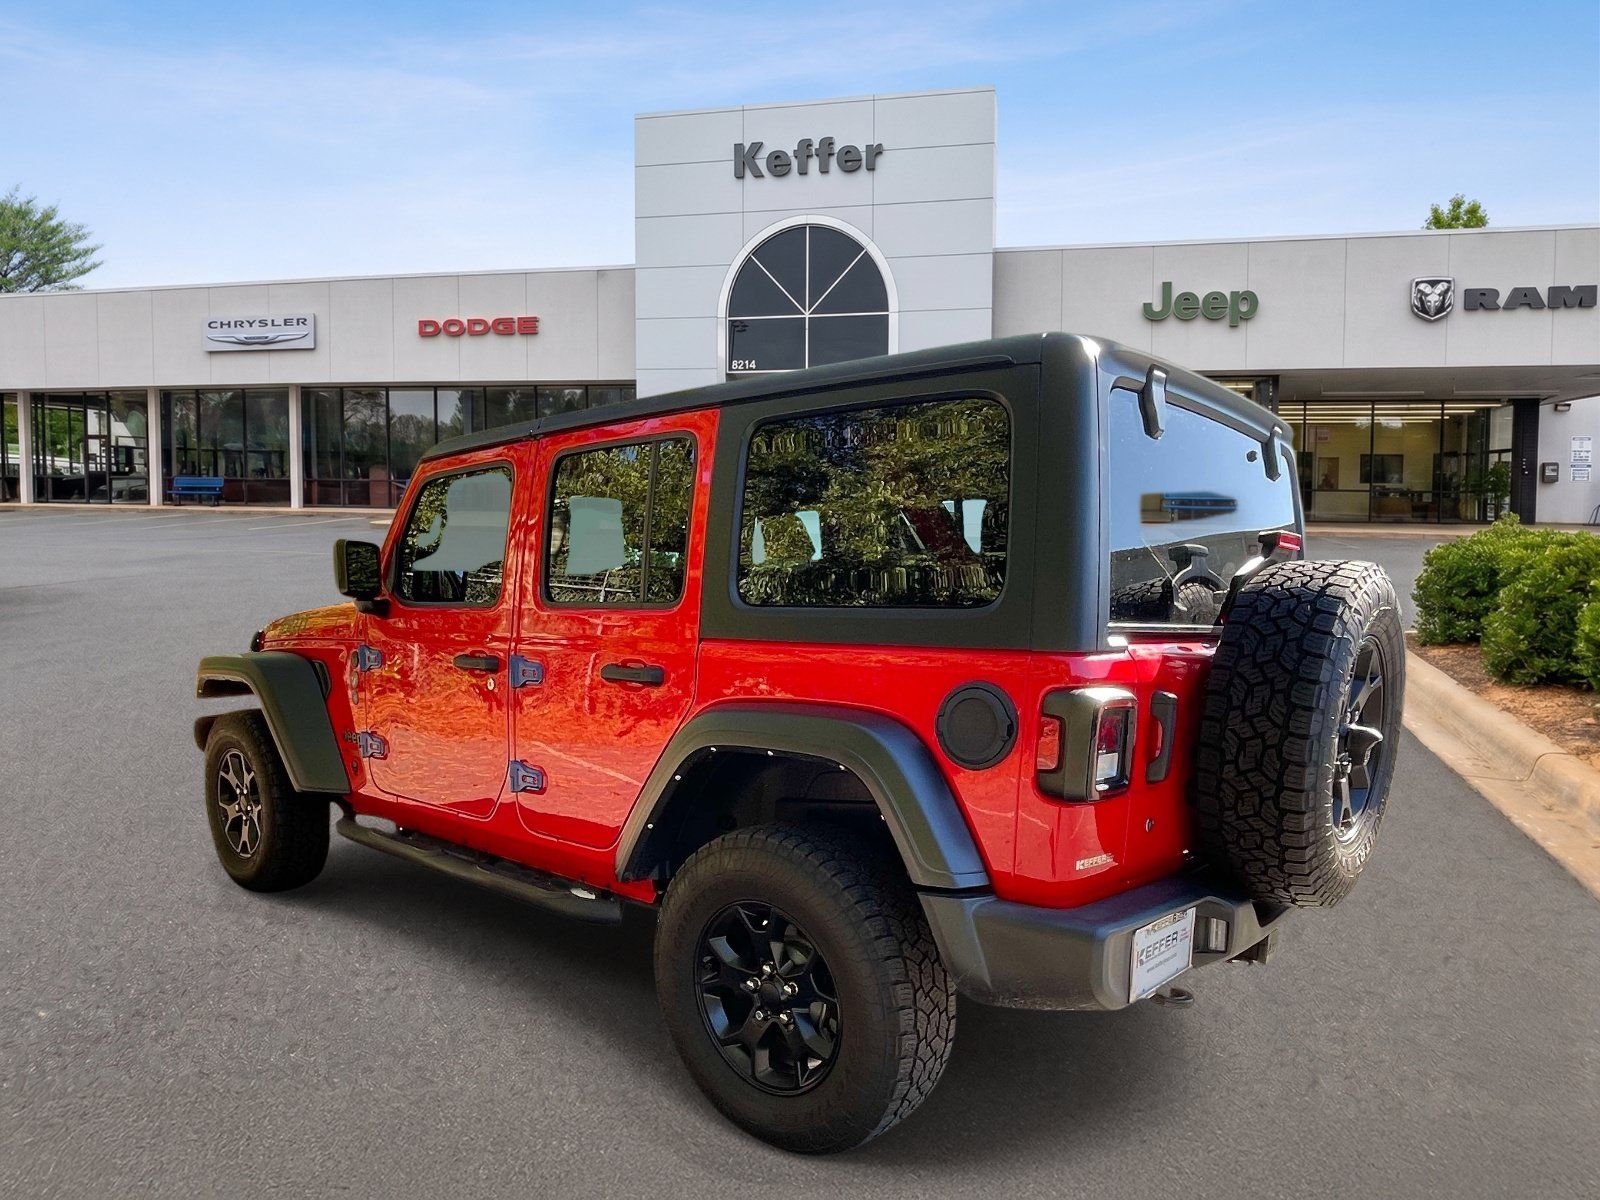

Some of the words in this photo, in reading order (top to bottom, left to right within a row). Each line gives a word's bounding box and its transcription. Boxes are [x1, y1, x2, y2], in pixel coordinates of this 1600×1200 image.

[733, 137, 883, 179] Keffer
[1143, 281, 1259, 328] Jeep
[1464, 285, 1598, 311] RAM
[207, 317, 308, 329] CHRYSLER
[418, 317, 539, 338] DODGE
[732, 360, 756, 370] 8214
[1136, 931, 1179, 968] KEFFER
